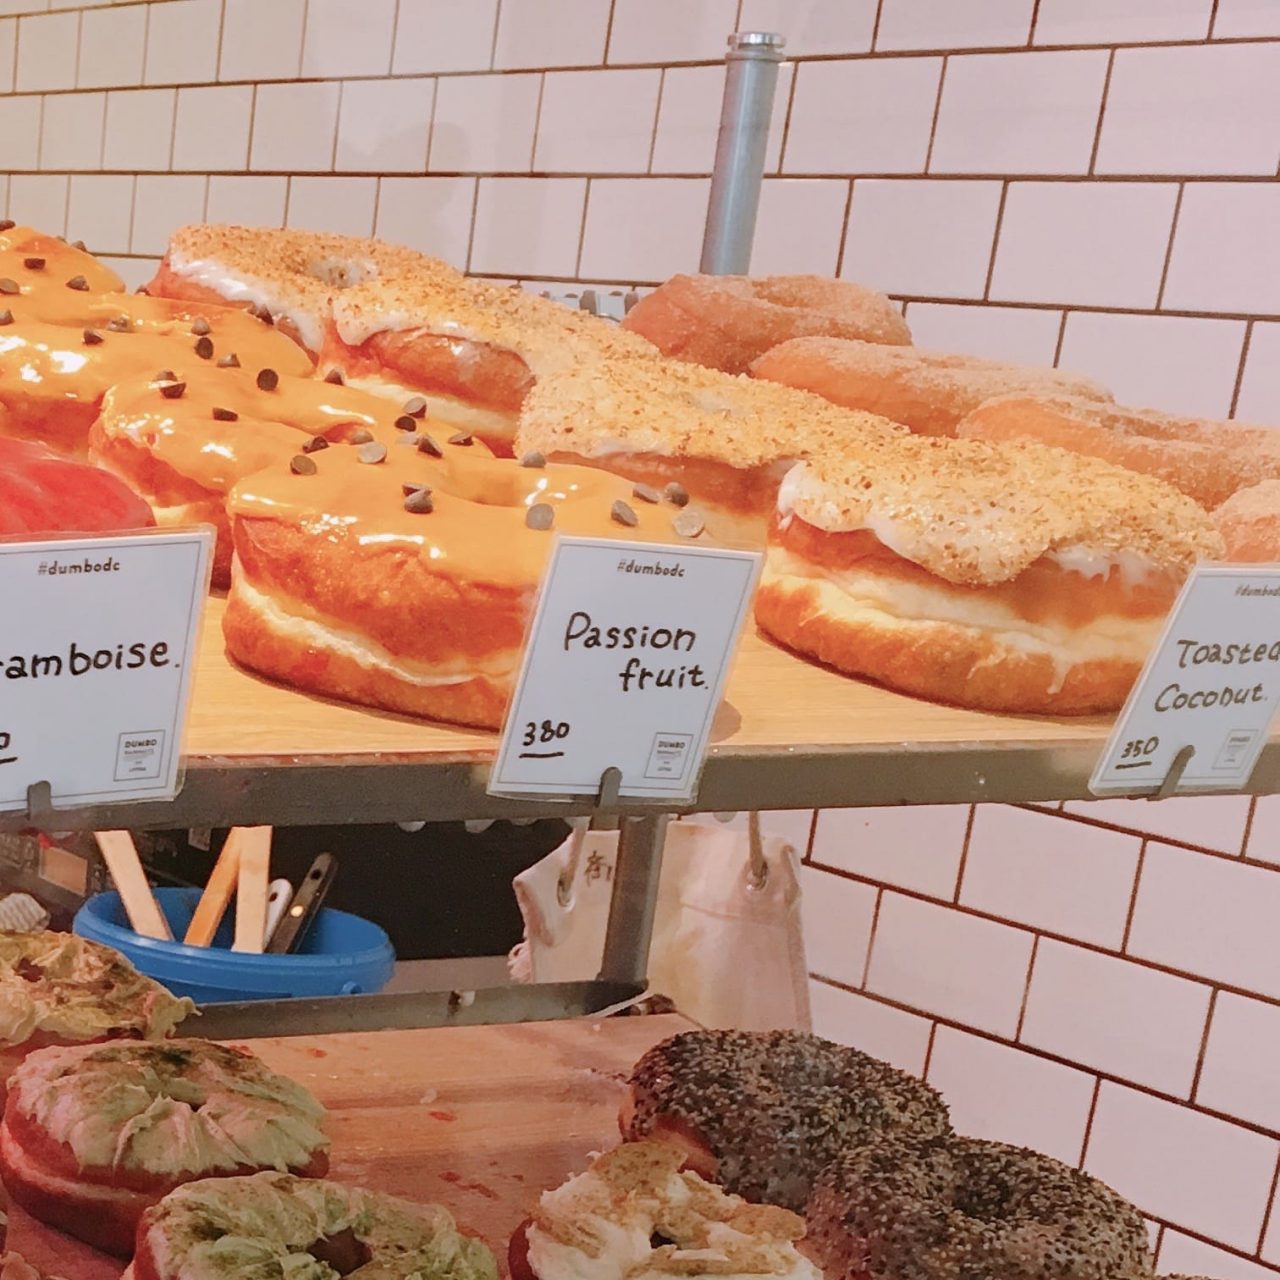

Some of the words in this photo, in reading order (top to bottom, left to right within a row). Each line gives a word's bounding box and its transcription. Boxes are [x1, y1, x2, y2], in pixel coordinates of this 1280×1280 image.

[37, 557, 120, 576] #dumbodc
[617, 560, 685, 577] #dumbodc
[564, 612, 696, 652] Passion
[619, 658, 709, 692] fruit.
[522, 720, 570, 746] 380
[1120, 736, 1159, 758] 350
